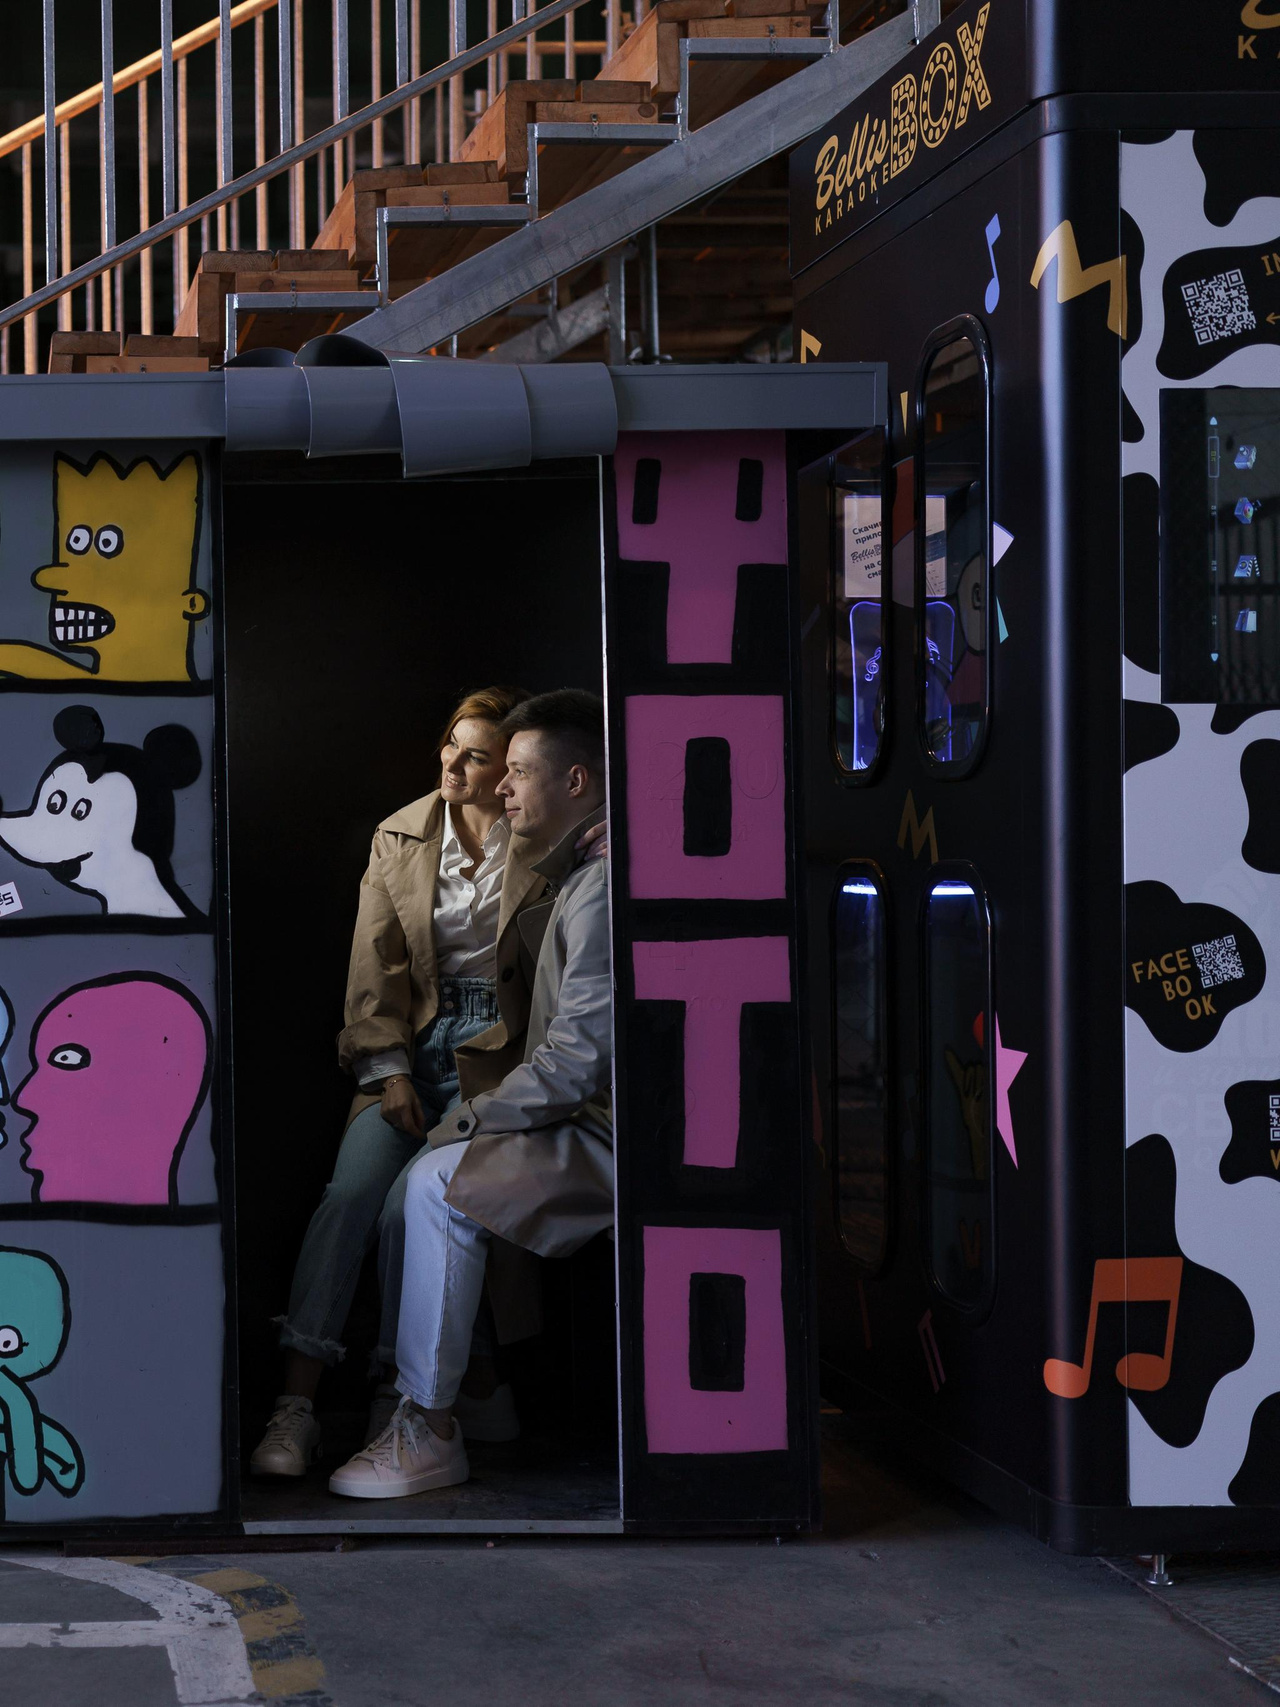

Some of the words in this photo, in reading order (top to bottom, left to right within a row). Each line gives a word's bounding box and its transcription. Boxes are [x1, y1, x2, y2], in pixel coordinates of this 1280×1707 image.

[814, 112, 890, 211] Bellis
[890, 2, 992, 180] BOX
[814, 162, 890, 236] KARAOKE
[864, 563, 876, 571] на
[1131, 948, 1191, 983] FACE
[1162, 975, 1192, 1001] BO
[1185, 993, 1217, 1020] OK
